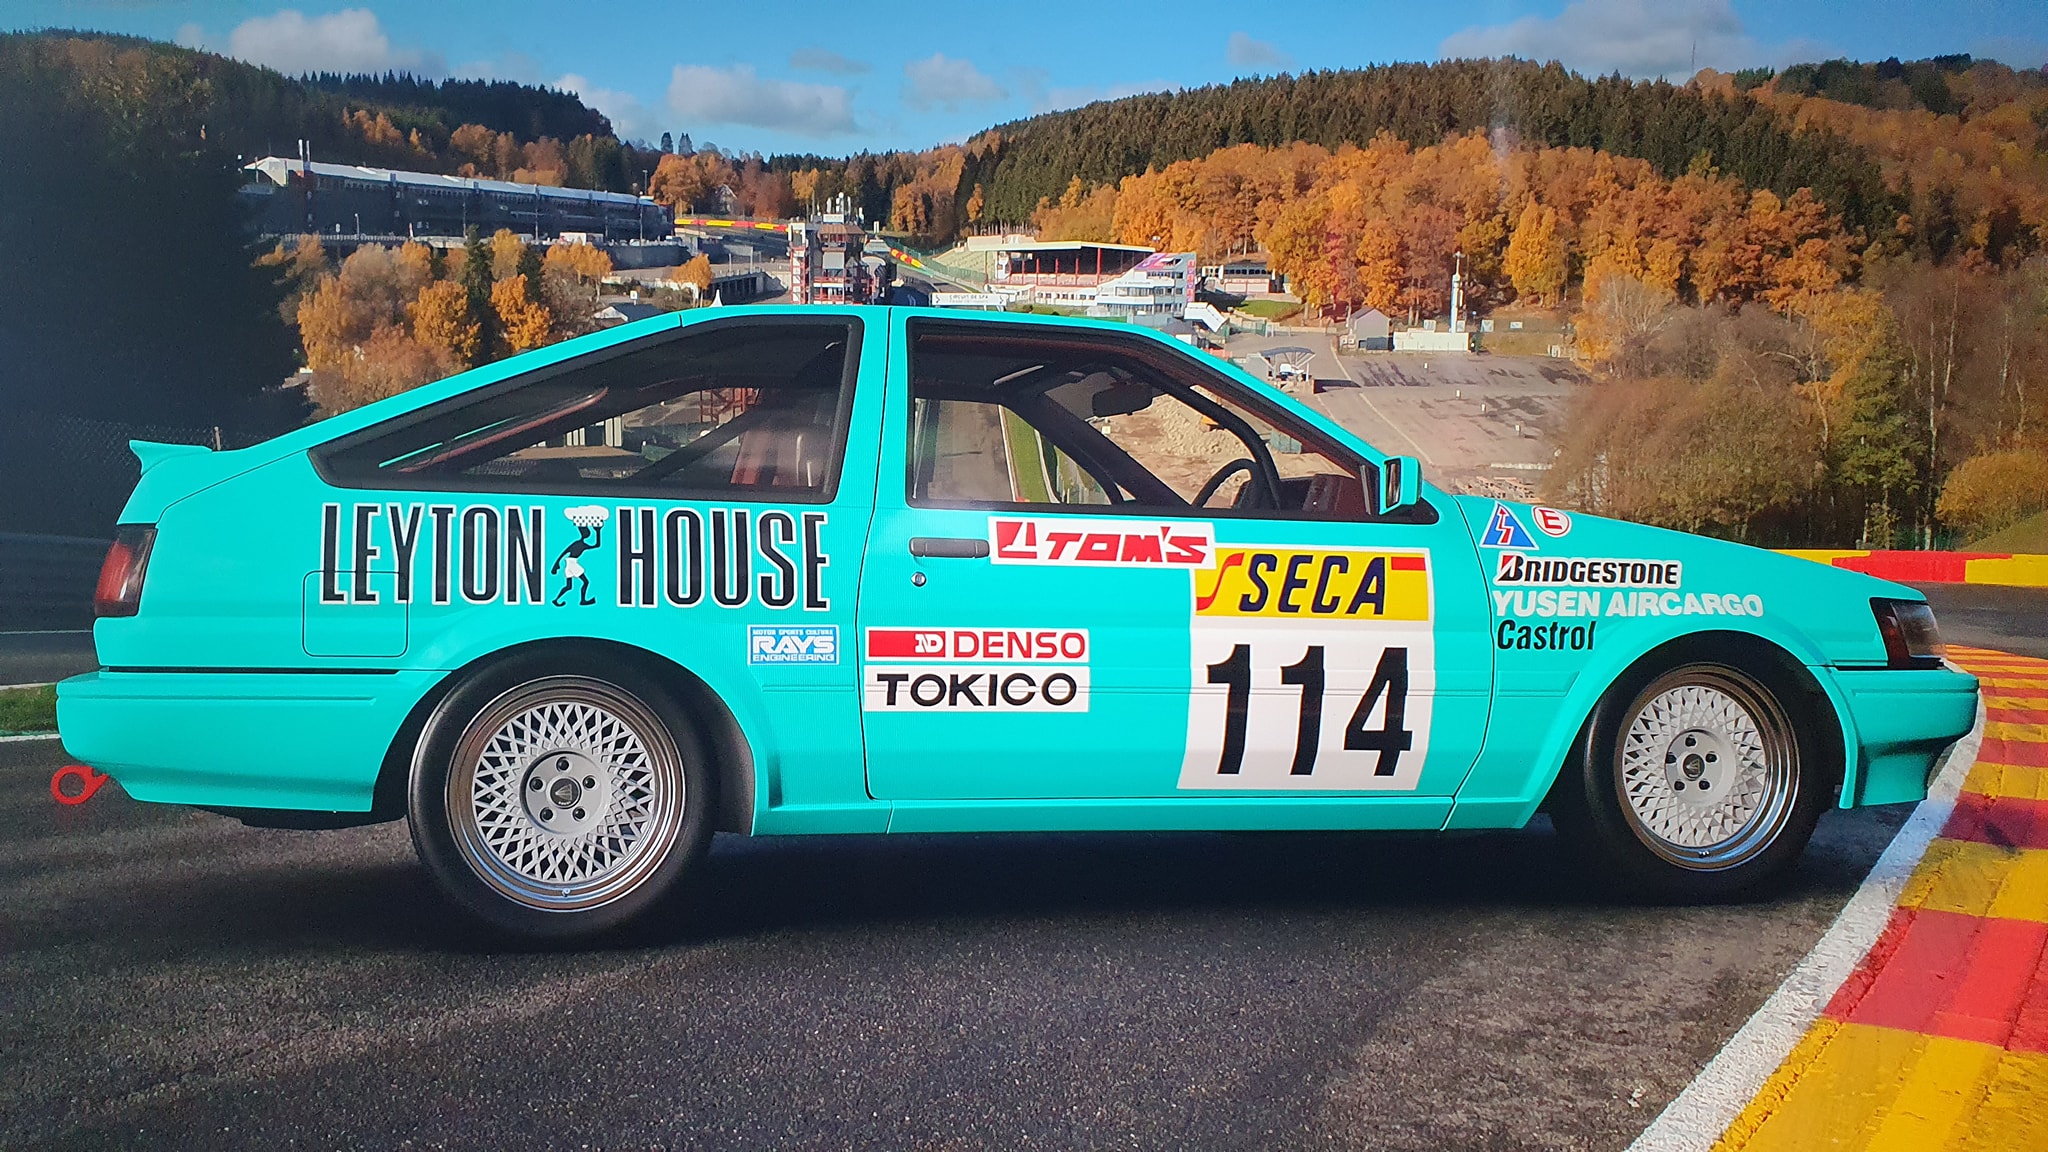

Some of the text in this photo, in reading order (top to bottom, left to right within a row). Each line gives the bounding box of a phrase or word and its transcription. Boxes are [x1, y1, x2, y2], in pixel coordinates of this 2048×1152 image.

[1538, 508, 1563, 530] E
[320, 502, 832, 612] LEYTON HOUSE
[1045, 526, 1208, 565] TOM'S
[1238, 553, 1386, 615] SECA
[1497, 554, 1679, 585] BRIDGESTONE
[1492, 590, 1764, 618] YUSEN AIRCARGO
[753, 635, 835, 654] RAYS
[953, 631, 1086, 659] DENSO
[1497, 619, 1597, 651] Castrol
[753, 654, 835, 662] ENGINEERING
[876, 672, 1078, 707] TOKICO
[1206, 643, 1413, 777] 114
